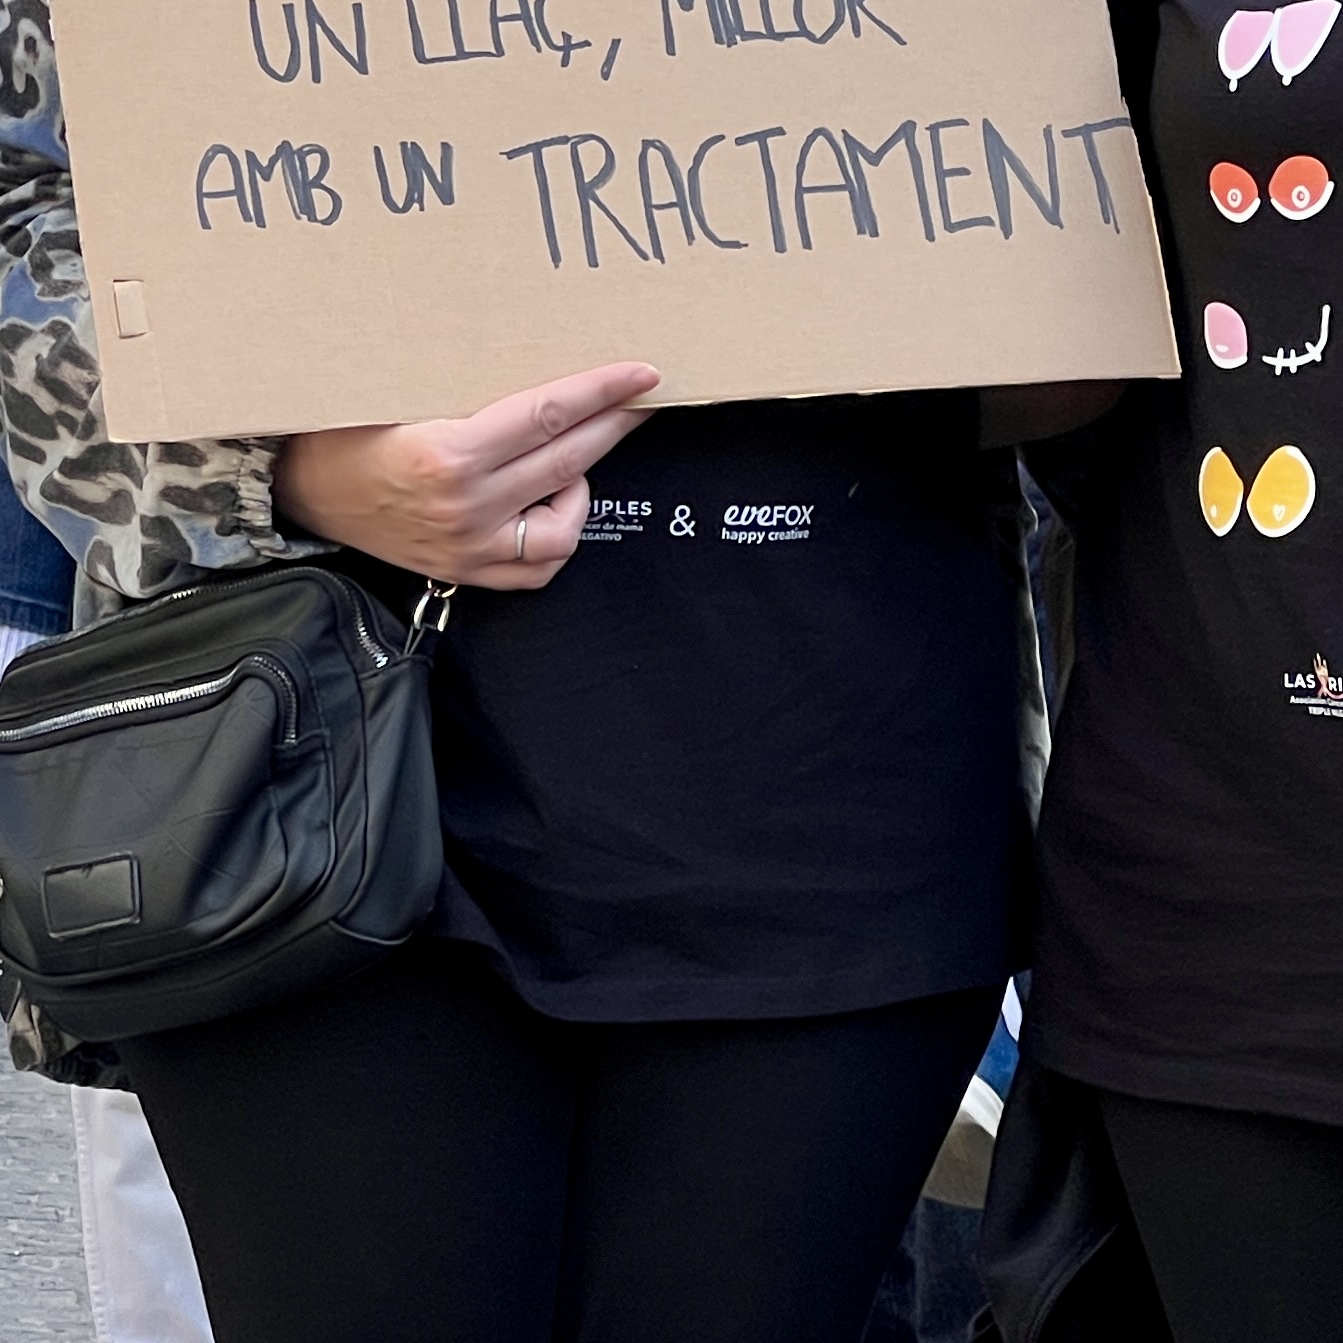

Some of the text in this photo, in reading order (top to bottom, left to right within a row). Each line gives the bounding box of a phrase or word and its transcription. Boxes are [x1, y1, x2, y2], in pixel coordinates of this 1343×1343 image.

[196, 116, 1134, 269] AMB UN TRACTAMENT
[669, 504, 696, 537] &
[721, 528, 810, 544] happy creative
[1283, 672, 1316, 689] LAS
